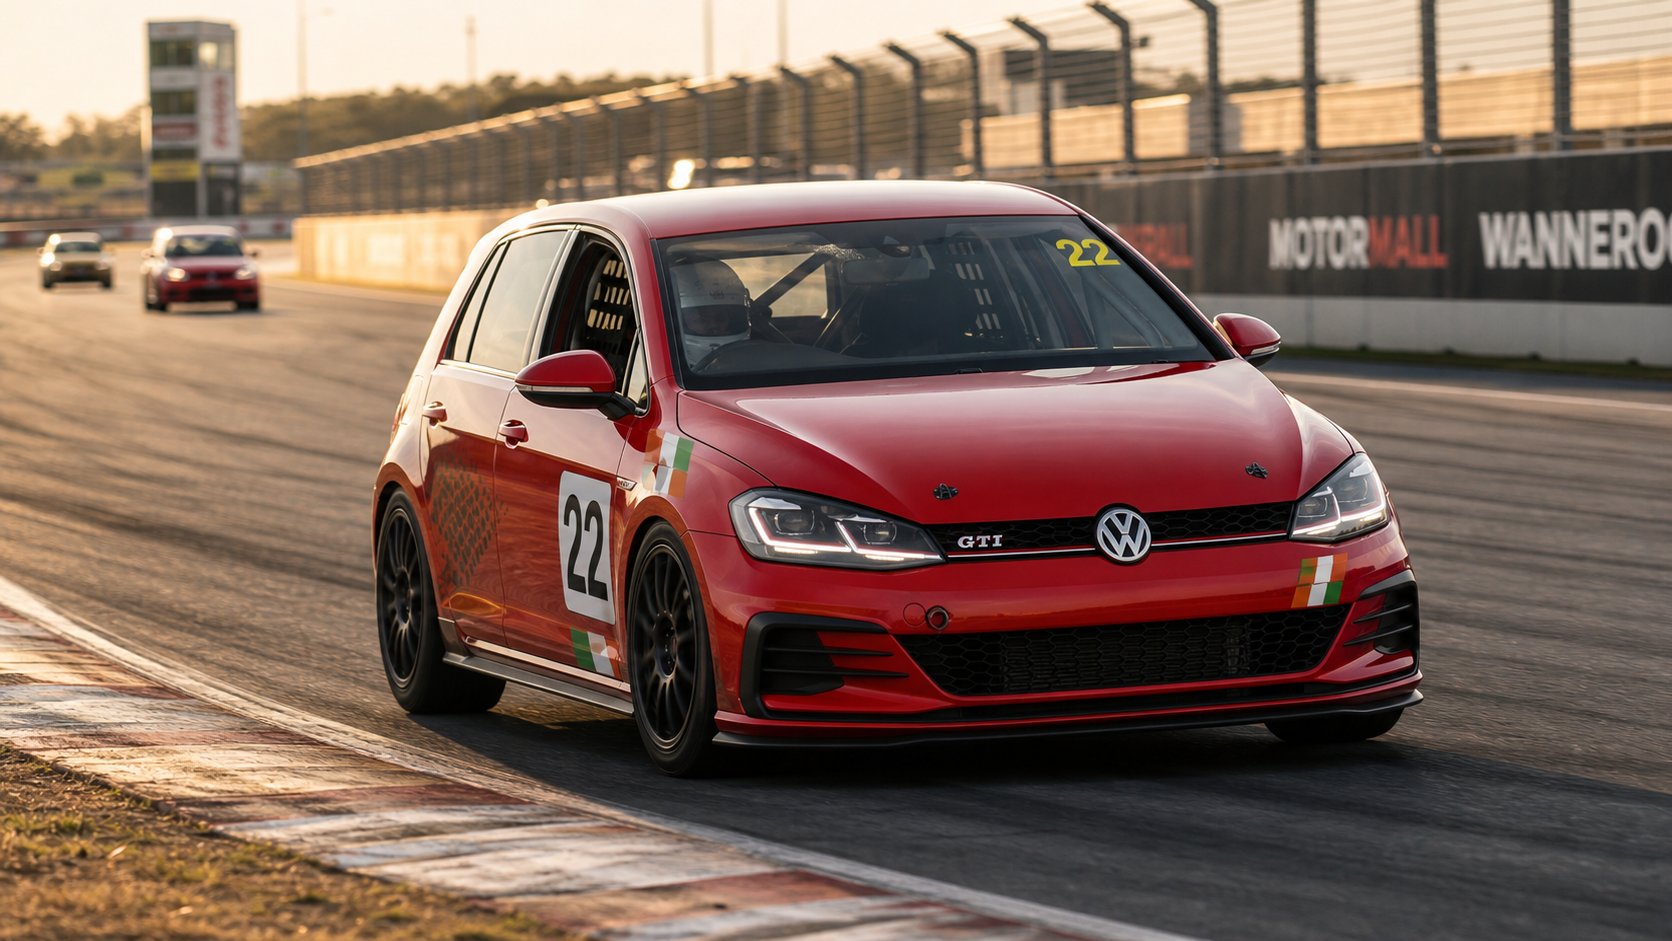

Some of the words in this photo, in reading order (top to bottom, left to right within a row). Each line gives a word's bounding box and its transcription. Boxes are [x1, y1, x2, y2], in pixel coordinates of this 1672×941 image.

[1055, 238, 1121, 267] 22
[1478, 207, 1672, 270] WANNERO
[563, 494, 609, 602] 22
[957, 534, 1003, 549] GTI
[1097, 508, 1151, 562] VW
